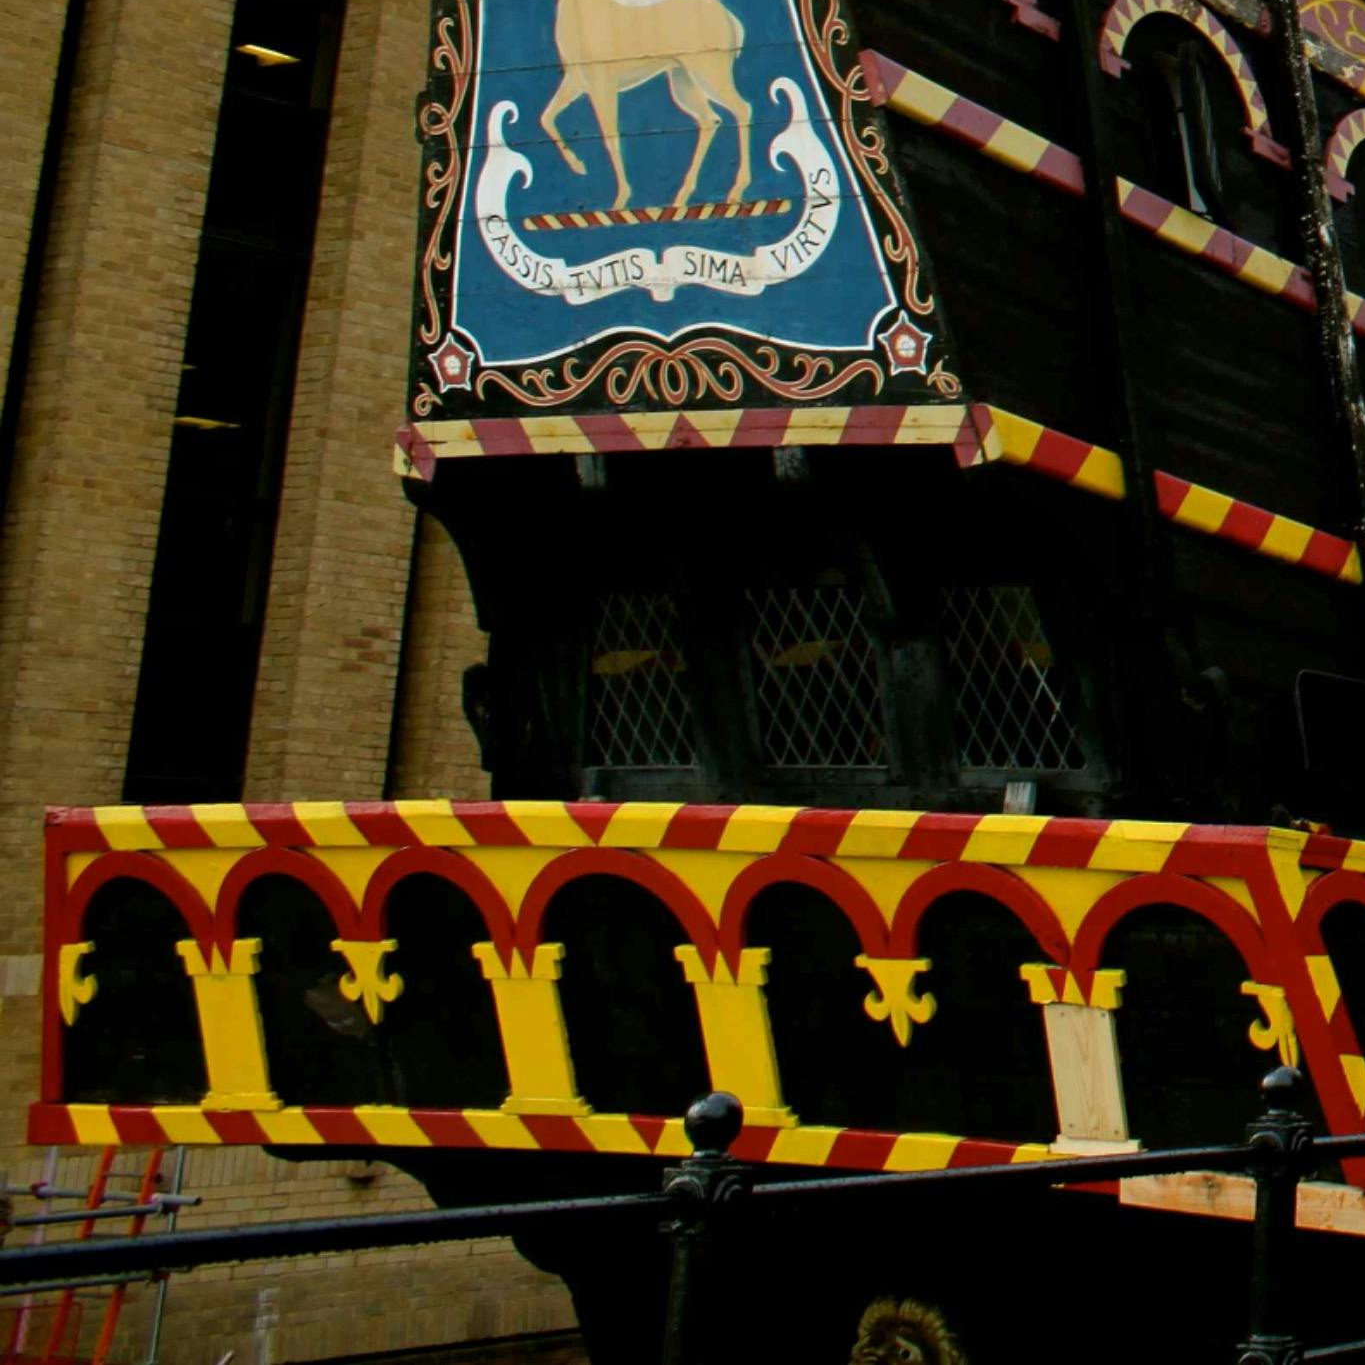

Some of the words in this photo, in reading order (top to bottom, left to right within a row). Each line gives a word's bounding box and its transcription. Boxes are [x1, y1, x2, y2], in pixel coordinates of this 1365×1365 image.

[485, 214, 554, 289] CASSIS
[569, 253, 645, 297] TVTIS
[684, 250, 748, 287] SIMA
[770, 165, 832, 274] VIRTVS
